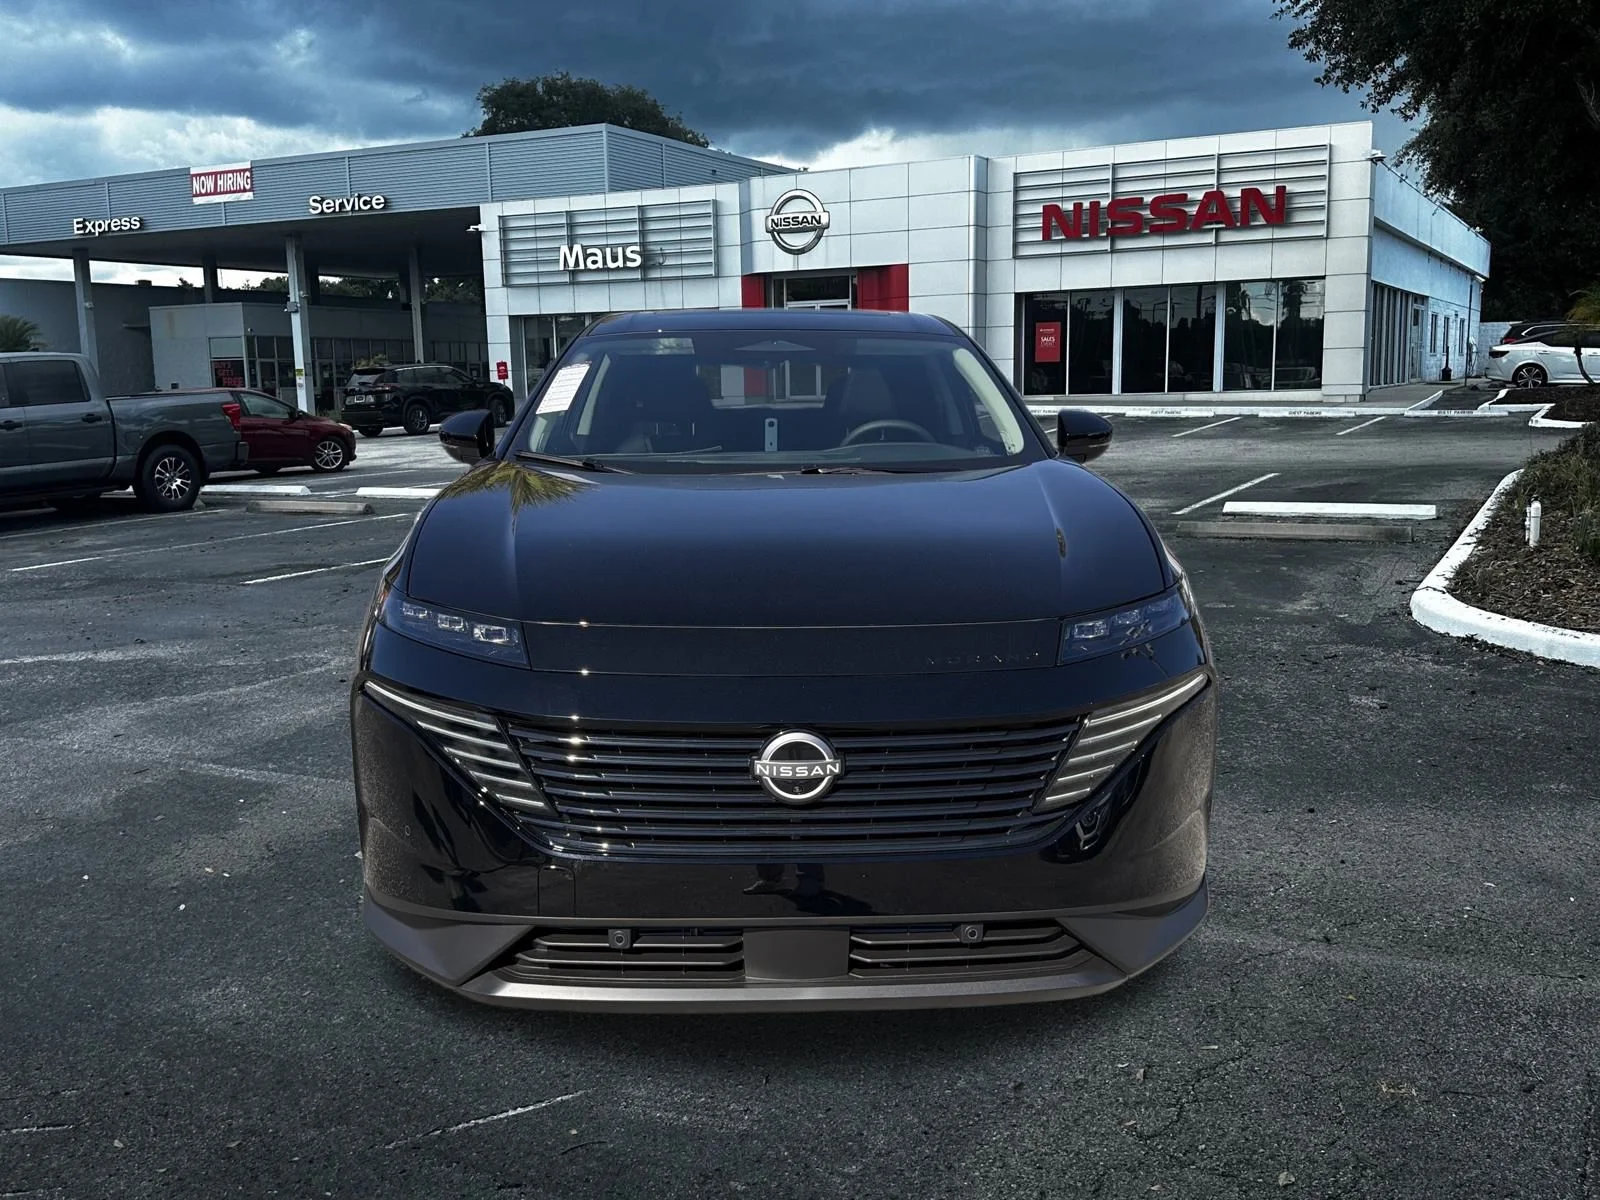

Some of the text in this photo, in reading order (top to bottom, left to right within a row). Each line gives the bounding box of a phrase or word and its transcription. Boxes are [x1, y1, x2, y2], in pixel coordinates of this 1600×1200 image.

[192, 171, 251, 195] NOW HIRING
[309, 193, 385, 214] Service
[1042, 185, 1287, 241] NISSAN
[73, 216, 141, 236] Express
[770, 214, 822, 228] NISSAN
[560, 243, 642, 271] Maus
[756, 762, 840, 777] NISSAN
